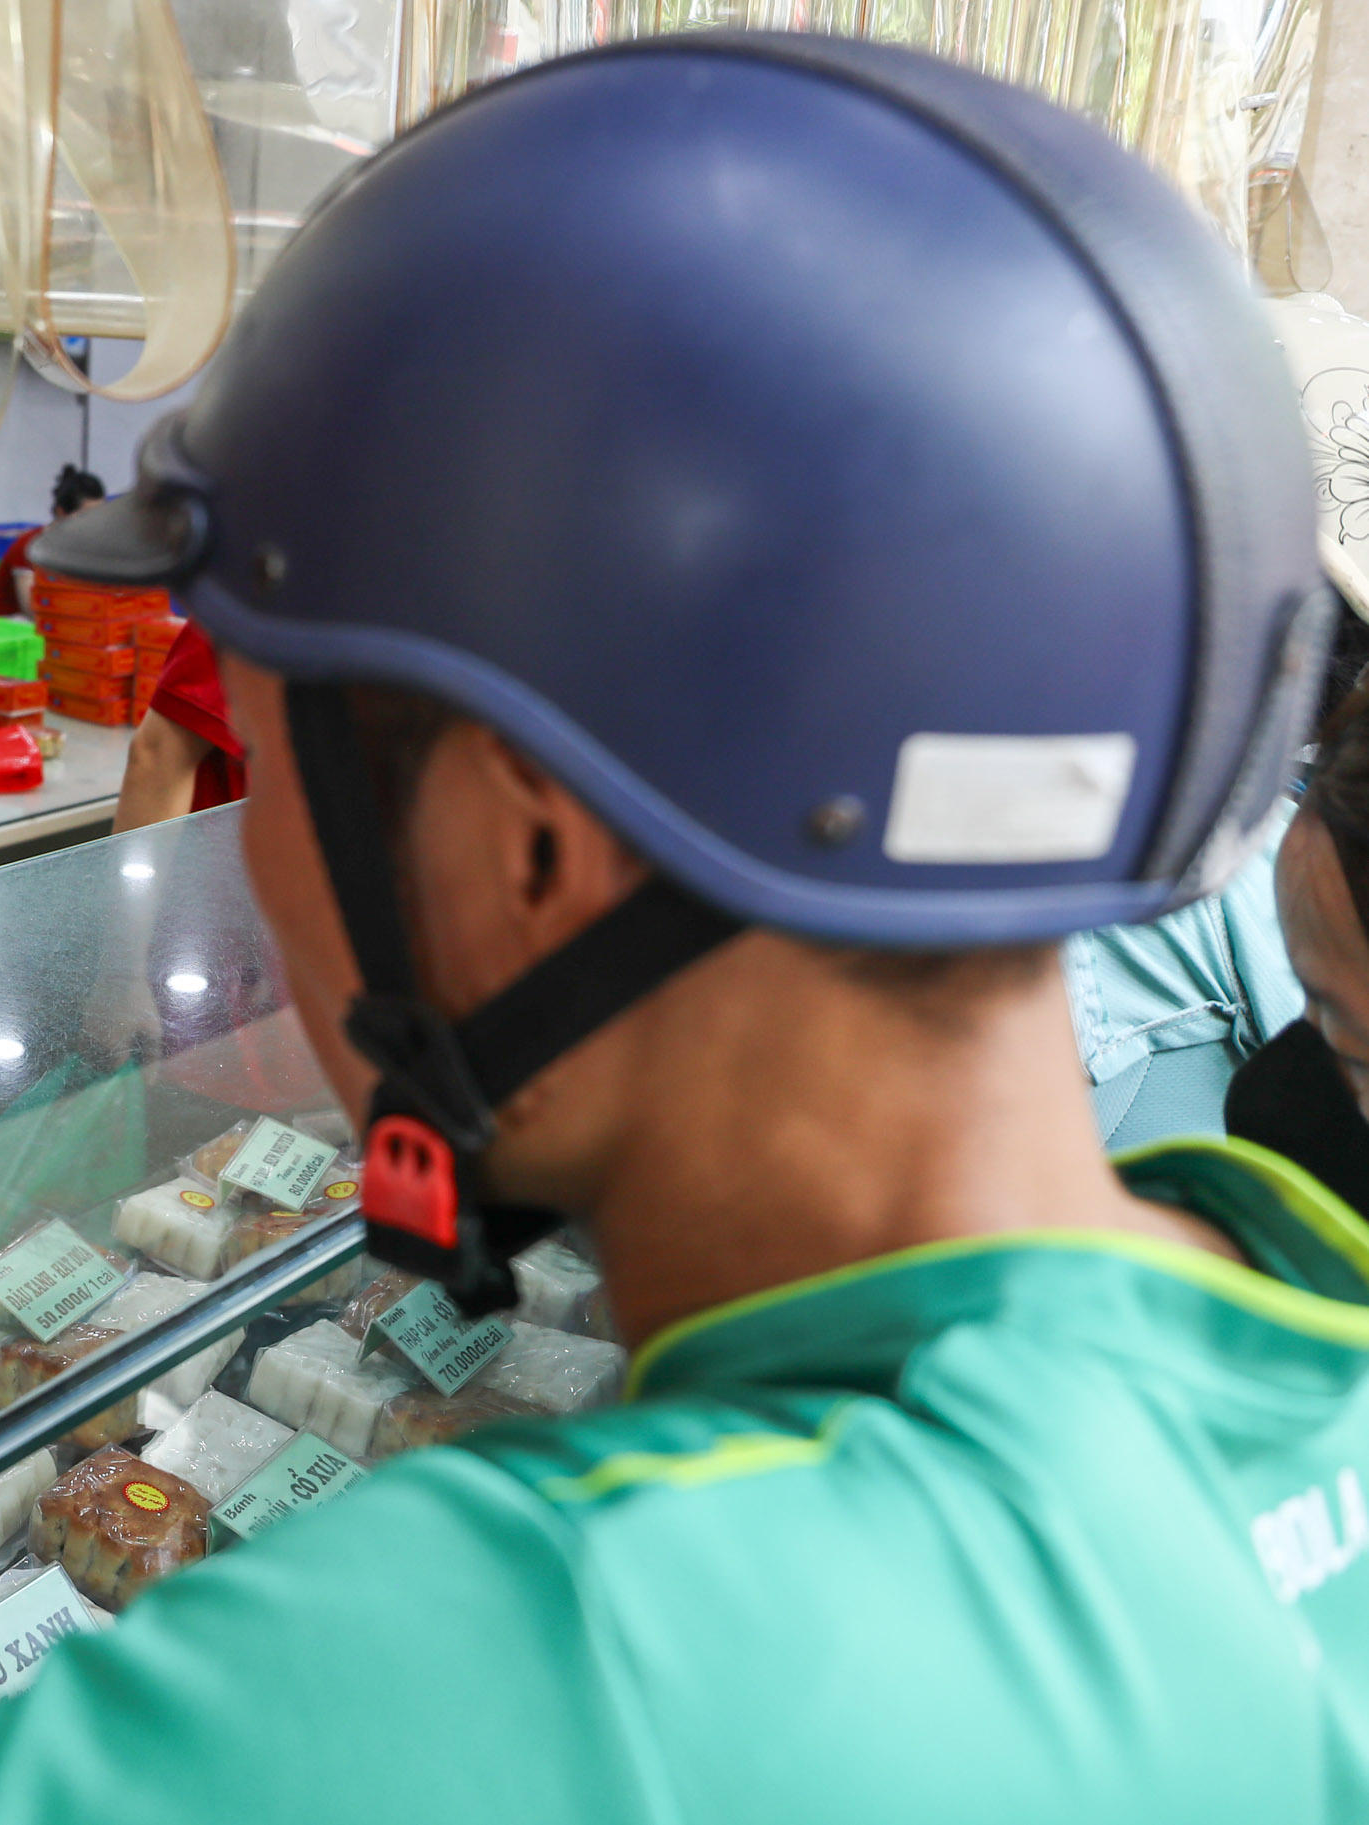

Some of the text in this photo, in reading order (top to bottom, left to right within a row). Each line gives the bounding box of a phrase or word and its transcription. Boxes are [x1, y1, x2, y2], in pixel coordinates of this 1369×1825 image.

[381, 1306, 406, 1328] Bánh
[438, 1325, 505, 1383] 70.000đ/cái
[287, 1467, 319, 1501] CỔ
[306, 1453, 347, 1486] XƯA
[223, 1492, 257, 1520] Bánh
[4, 1606, 79, 1673] XANH
